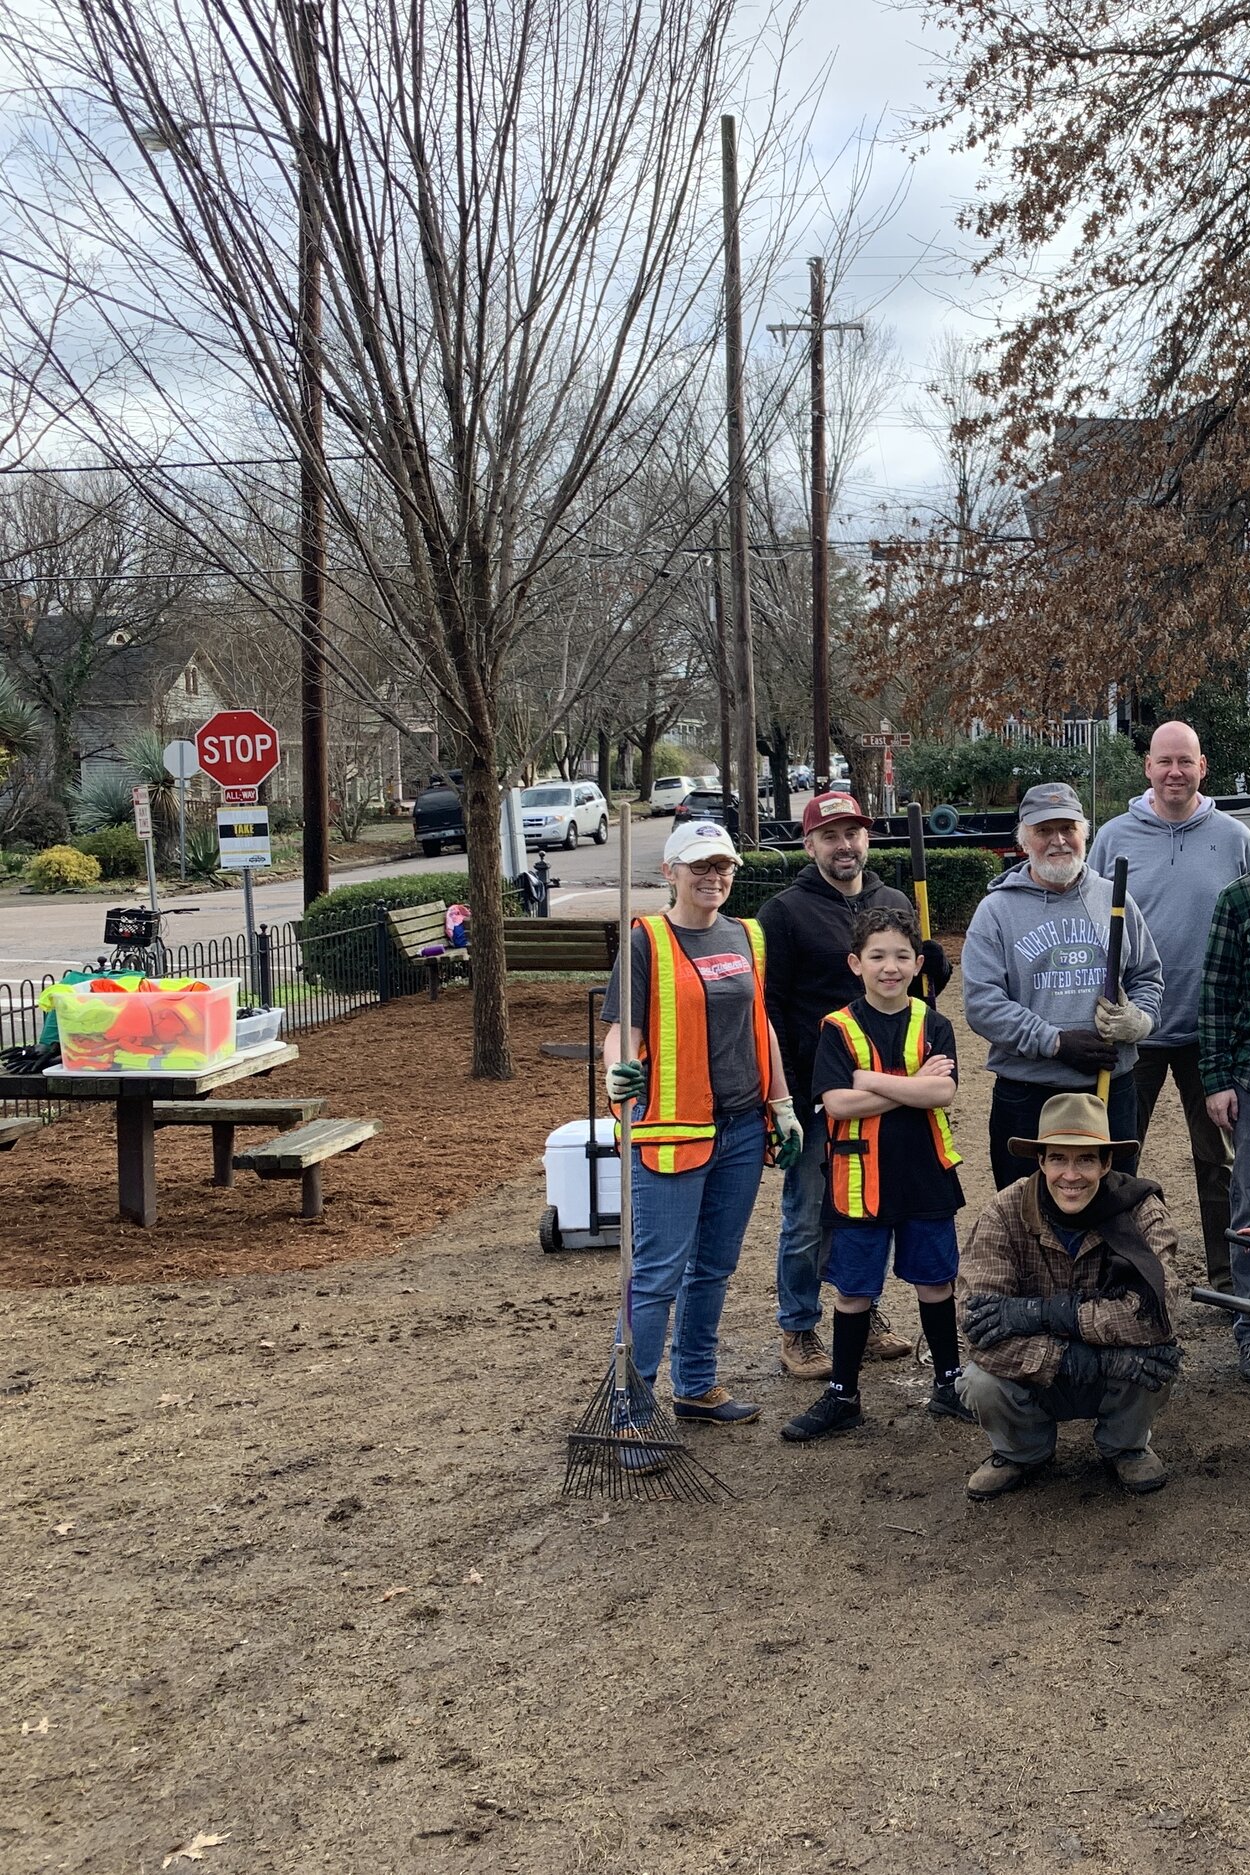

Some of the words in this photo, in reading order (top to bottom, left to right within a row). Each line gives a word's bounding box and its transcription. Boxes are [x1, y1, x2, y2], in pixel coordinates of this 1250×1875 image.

[870, 736, 887, 745] East
[203, 734, 272, 764] STOP
[226, 790, 256, 800] ALL-WAY
[233, 823, 255, 835] TAKE
[1014, 920, 1061, 962] NORTH
[1061, 918, 1111, 951] CAROLIN
[1033, 971, 1072, 989] UNITED
[1075, 968, 1107, 986] STATE
